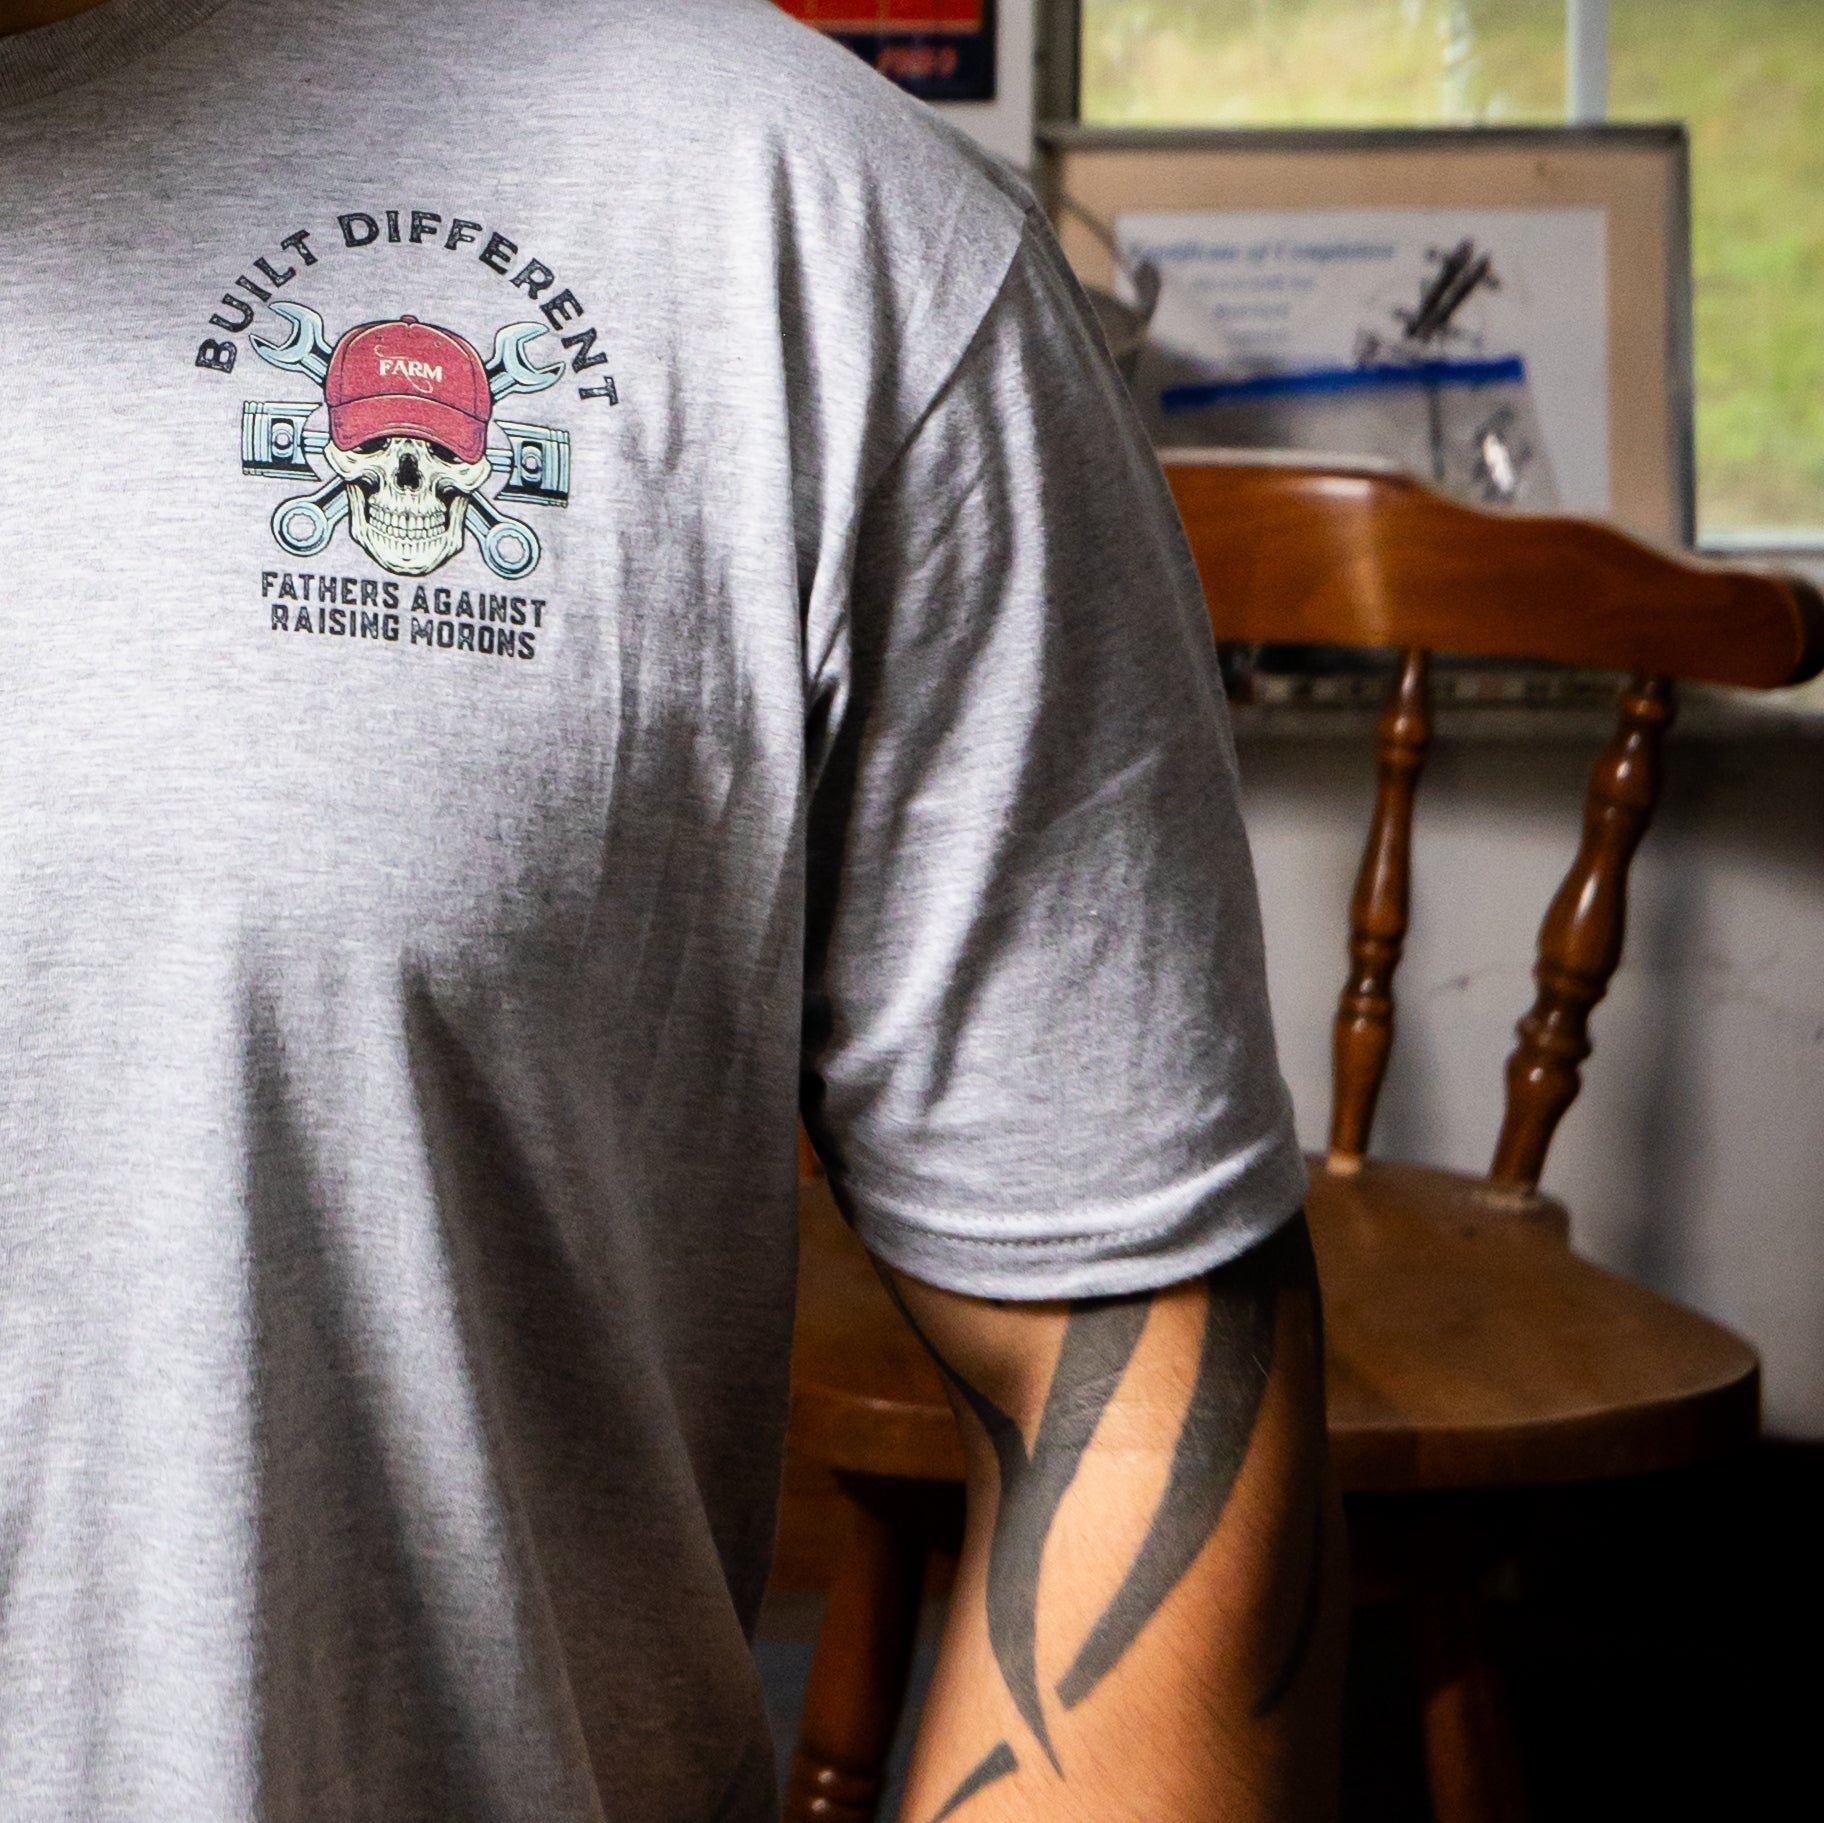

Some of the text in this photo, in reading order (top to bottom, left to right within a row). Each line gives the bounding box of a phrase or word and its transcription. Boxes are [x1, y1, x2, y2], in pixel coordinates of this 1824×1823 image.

[195, 210, 619, 407] BUILT DIFFERENT
[379, 359, 443, 384] FARM
[261, 571, 547, 627] FATHERS AGAINST
[271, 604, 536, 660] RAISING MORONS
